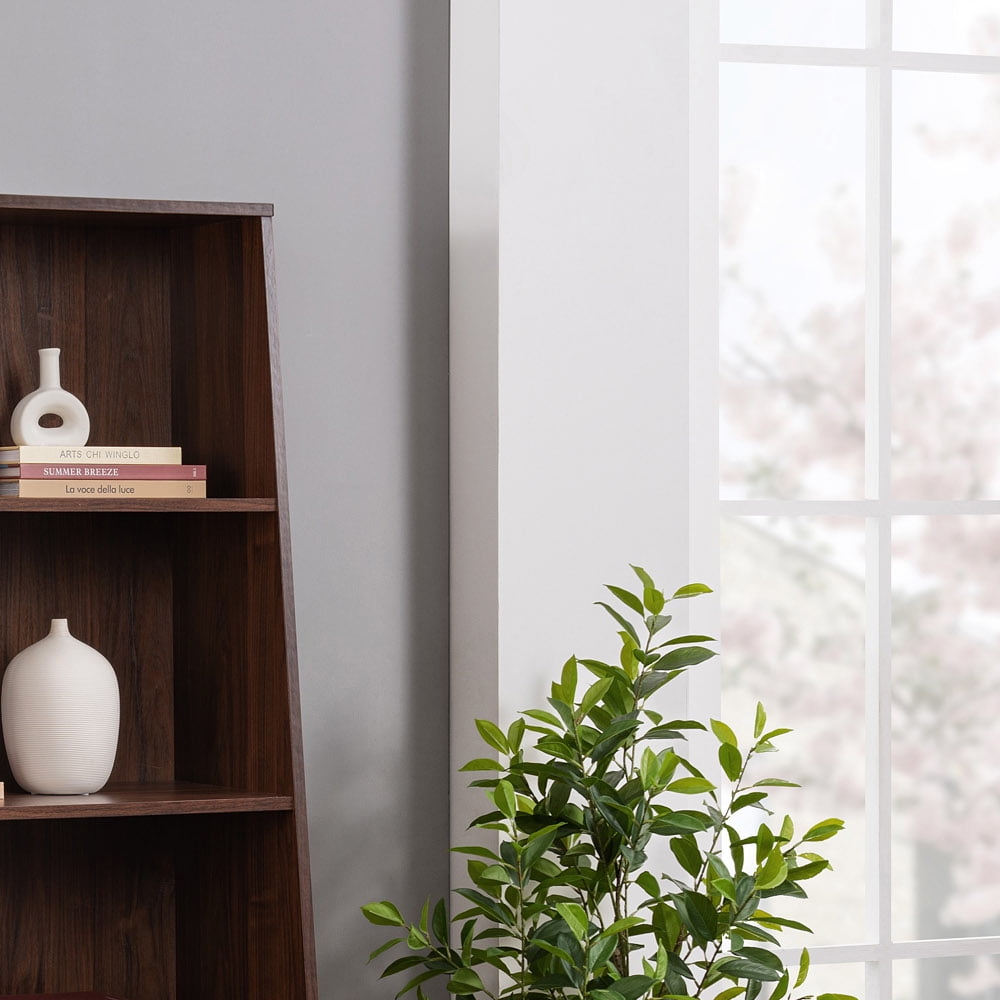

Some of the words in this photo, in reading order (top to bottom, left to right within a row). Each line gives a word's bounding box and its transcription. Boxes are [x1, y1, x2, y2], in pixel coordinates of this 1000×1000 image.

[59, 450, 82, 459] ARTS
[86, 450, 101, 459] CHI
[43, 467, 82, 477] SUMMER
[84, 467, 119, 477] BREEZE
[65, 485, 75, 494] La
[77, 486, 96, 494] voce
[97, 484, 117, 494] della
[118, 484, 135, 494] luce
